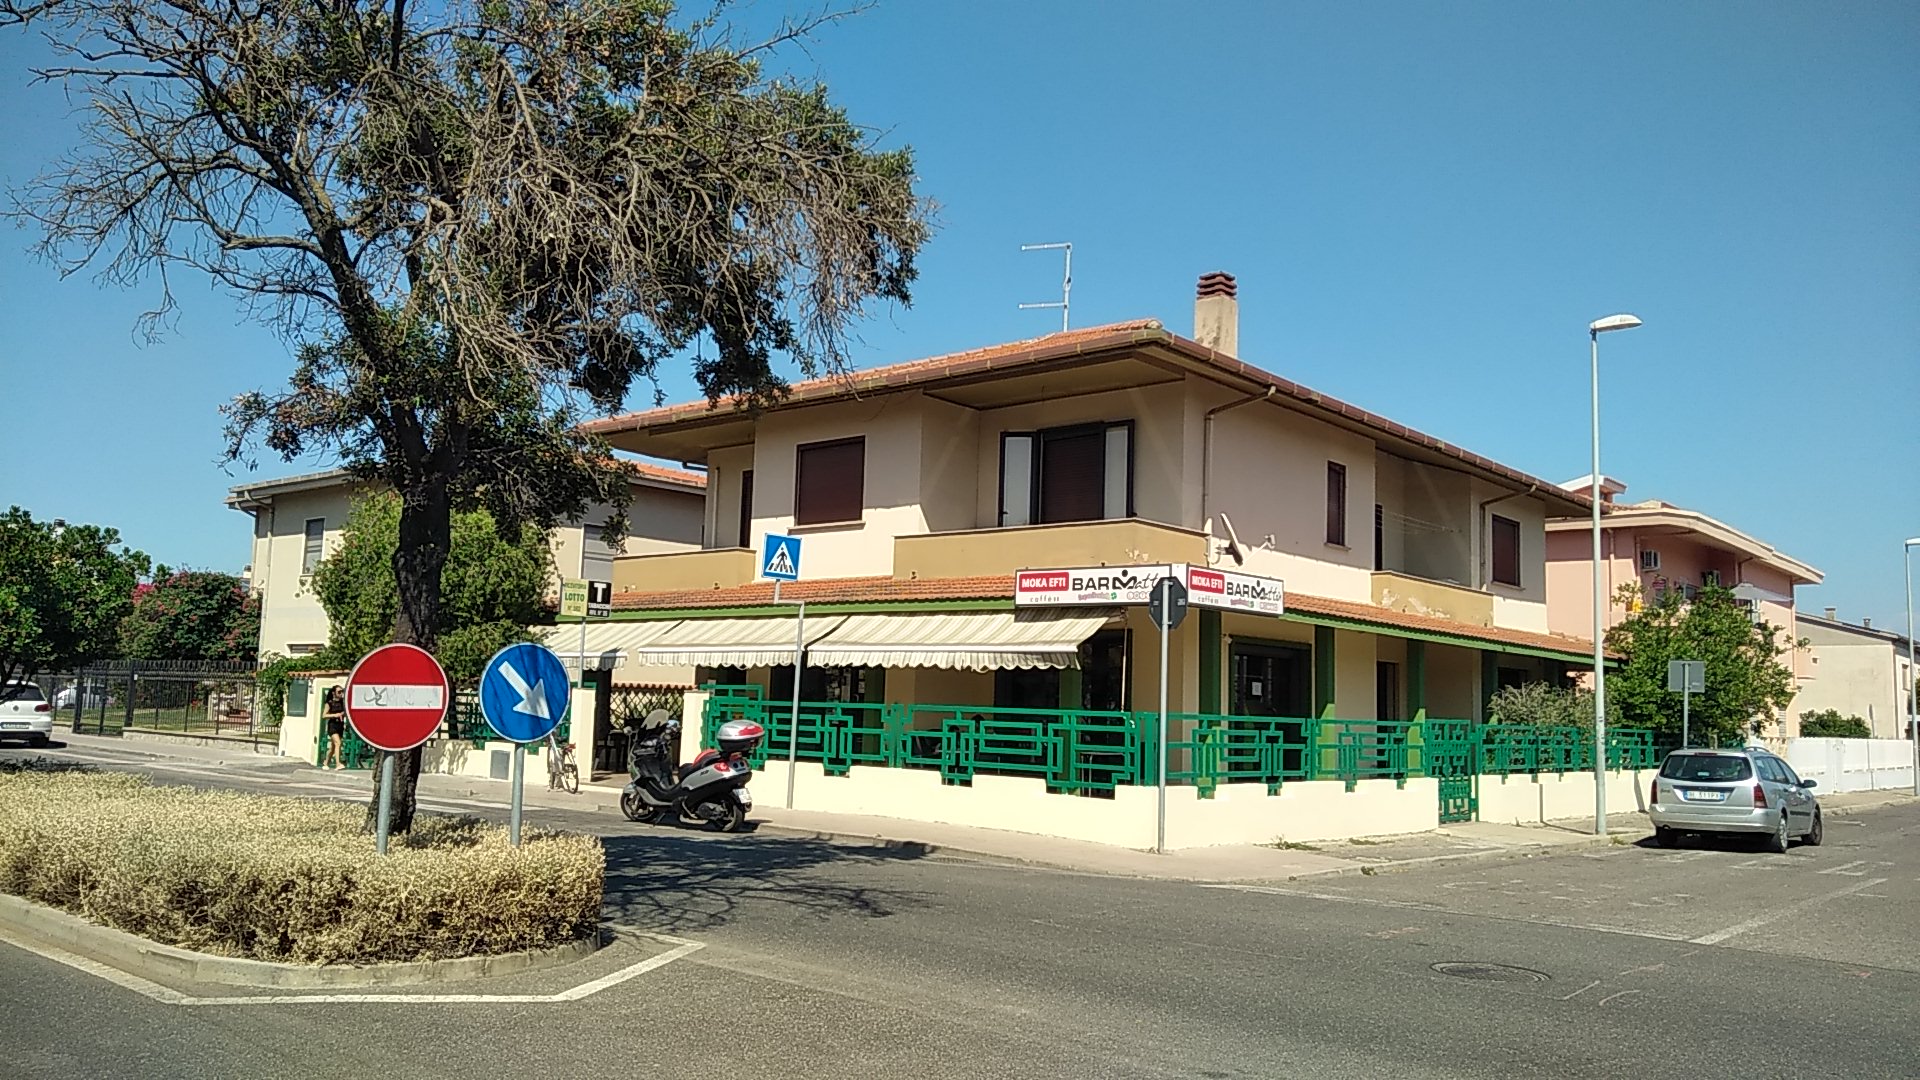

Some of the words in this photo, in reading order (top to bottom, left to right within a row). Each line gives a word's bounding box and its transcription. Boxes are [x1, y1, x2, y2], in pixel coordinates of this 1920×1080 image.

[1022, 578, 1047, 588] MOKA
[1048, 577, 1066, 587] EFTI
[1072, 577, 1109, 591] BAR
[1112, 570, 1159, 591] Matt
[1192, 576, 1210, 588] MOKA
[1210, 578, 1223, 590] EFTI
[565, 593, 585, 602] LOTTO
[594, 582, 607, 602] T
[1226, 582, 1250, 598] BAR
